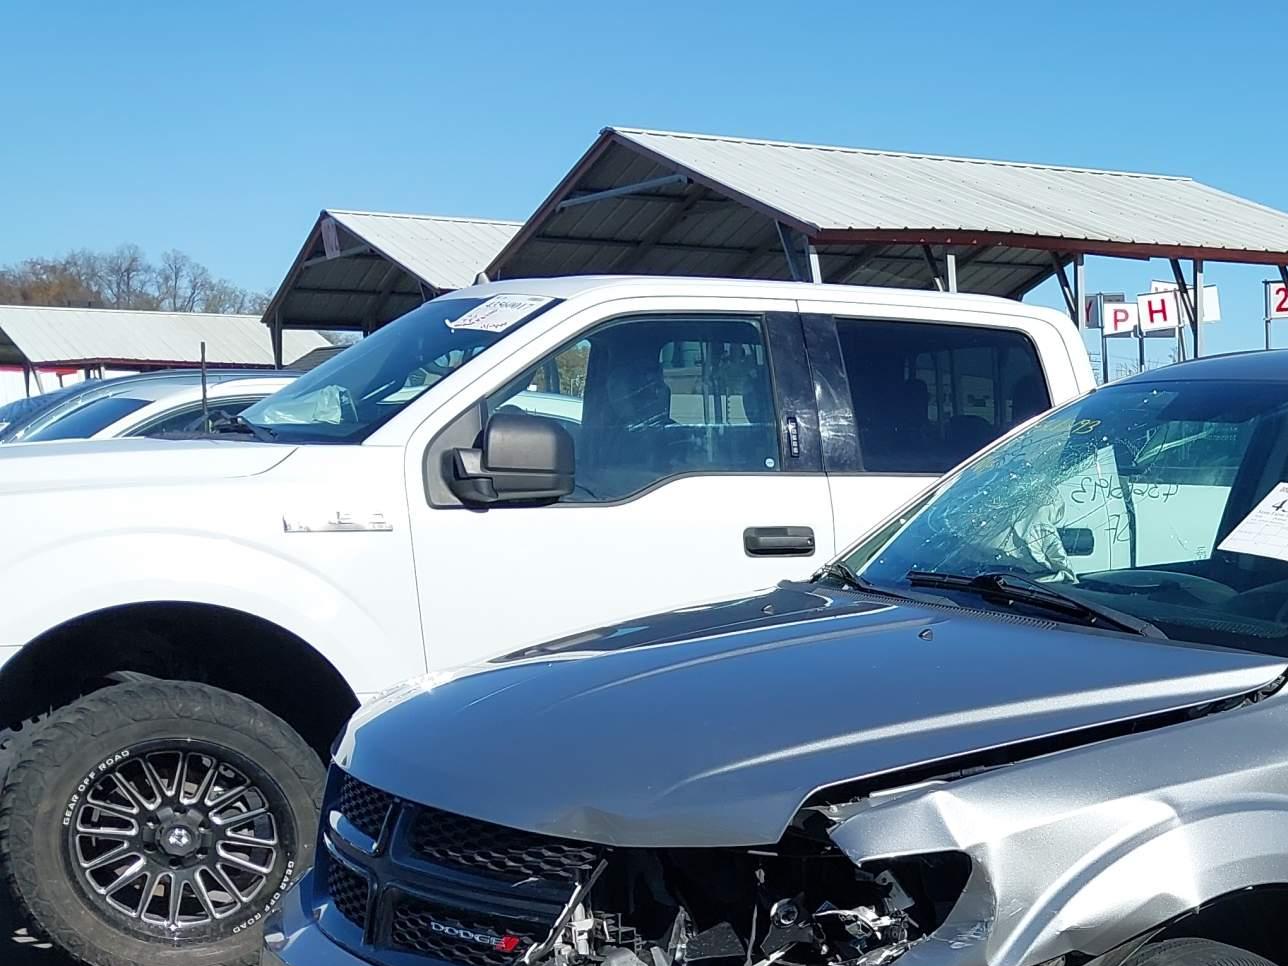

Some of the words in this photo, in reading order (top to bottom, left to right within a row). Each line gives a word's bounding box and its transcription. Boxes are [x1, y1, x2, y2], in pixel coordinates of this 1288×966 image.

[1112, 308, 1130, 332] P
[1147, 298, 1168, 324] H
[62, 794, 80, 826] GEAR
[77, 771, 96, 792] OFF
[98, 750, 130, 772] ROAD
[279, 860, 295, 891] GEAR
[264, 891, 281, 913] OFF
[232, 912, 262, 934] ROAD
[430, 921, 506, 948] DODGE
